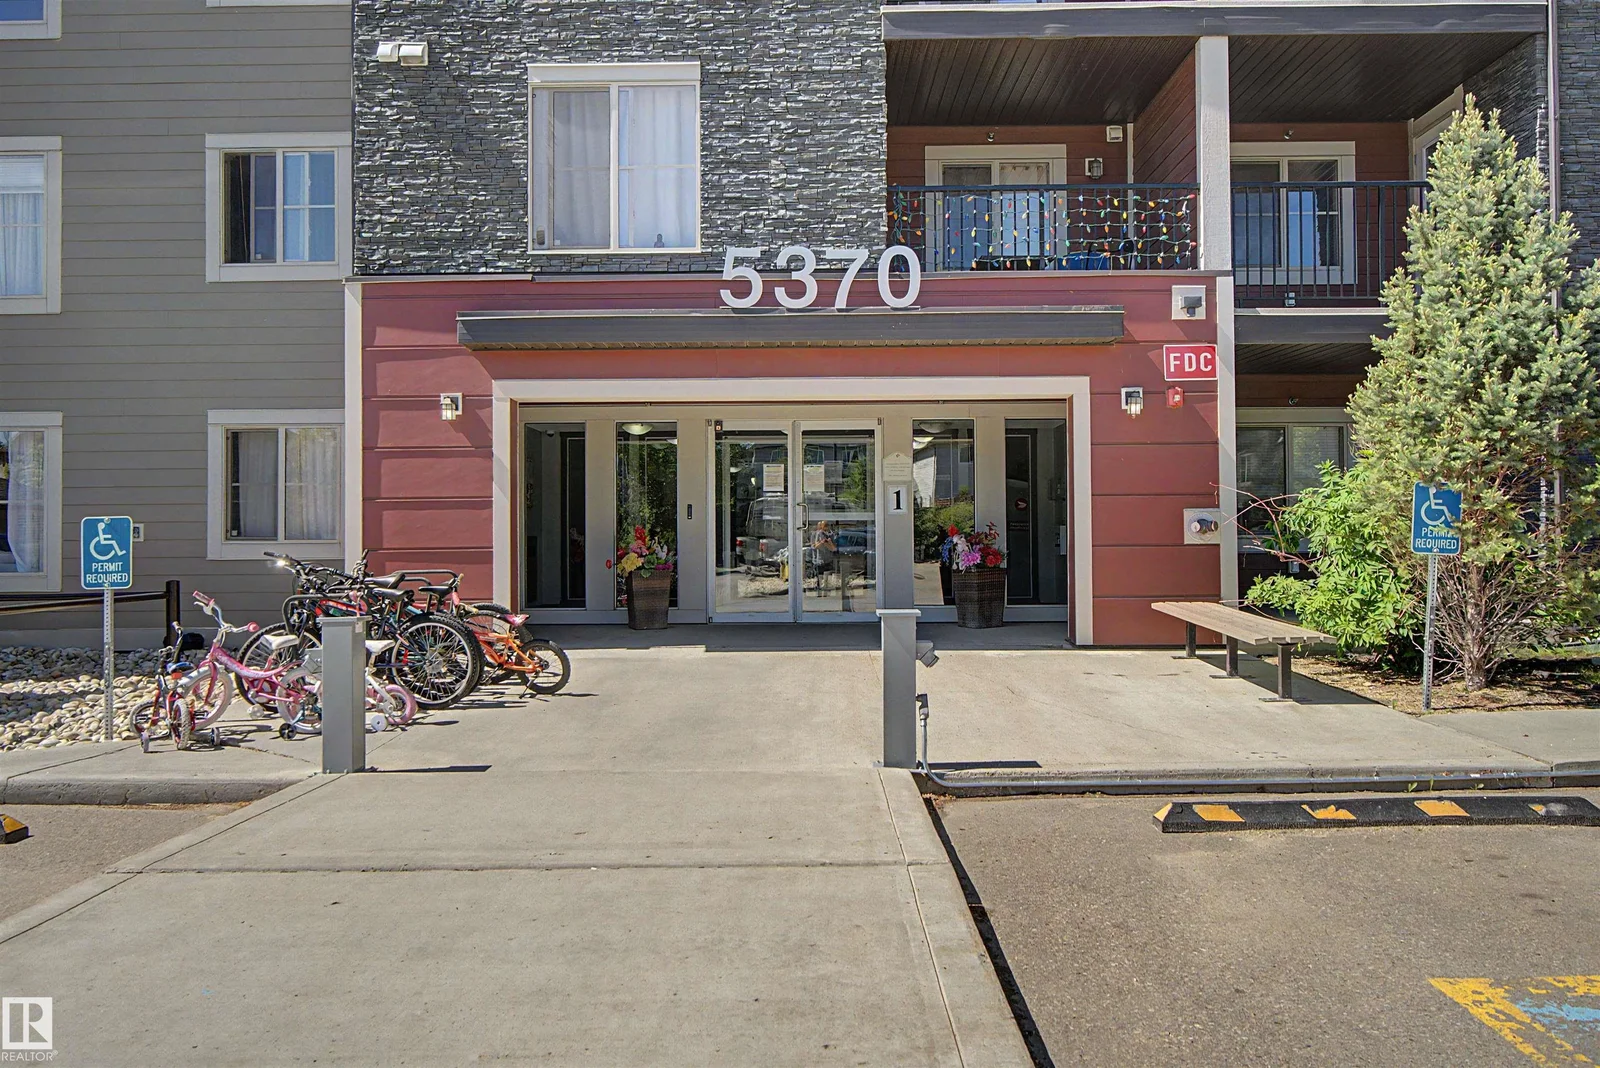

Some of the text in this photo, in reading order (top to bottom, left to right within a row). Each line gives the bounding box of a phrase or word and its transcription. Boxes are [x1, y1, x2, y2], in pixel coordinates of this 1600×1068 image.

[719, 245, 921, 308] 5370
[1169, 352, 1213, 373] FDC
[892, 489, 904, 511] 1
[1415, 538, 1457, 550] REQUIRED
[92, 561, 123, 573] PERMIT
[86, 572, 129, 584] REQUIRED
